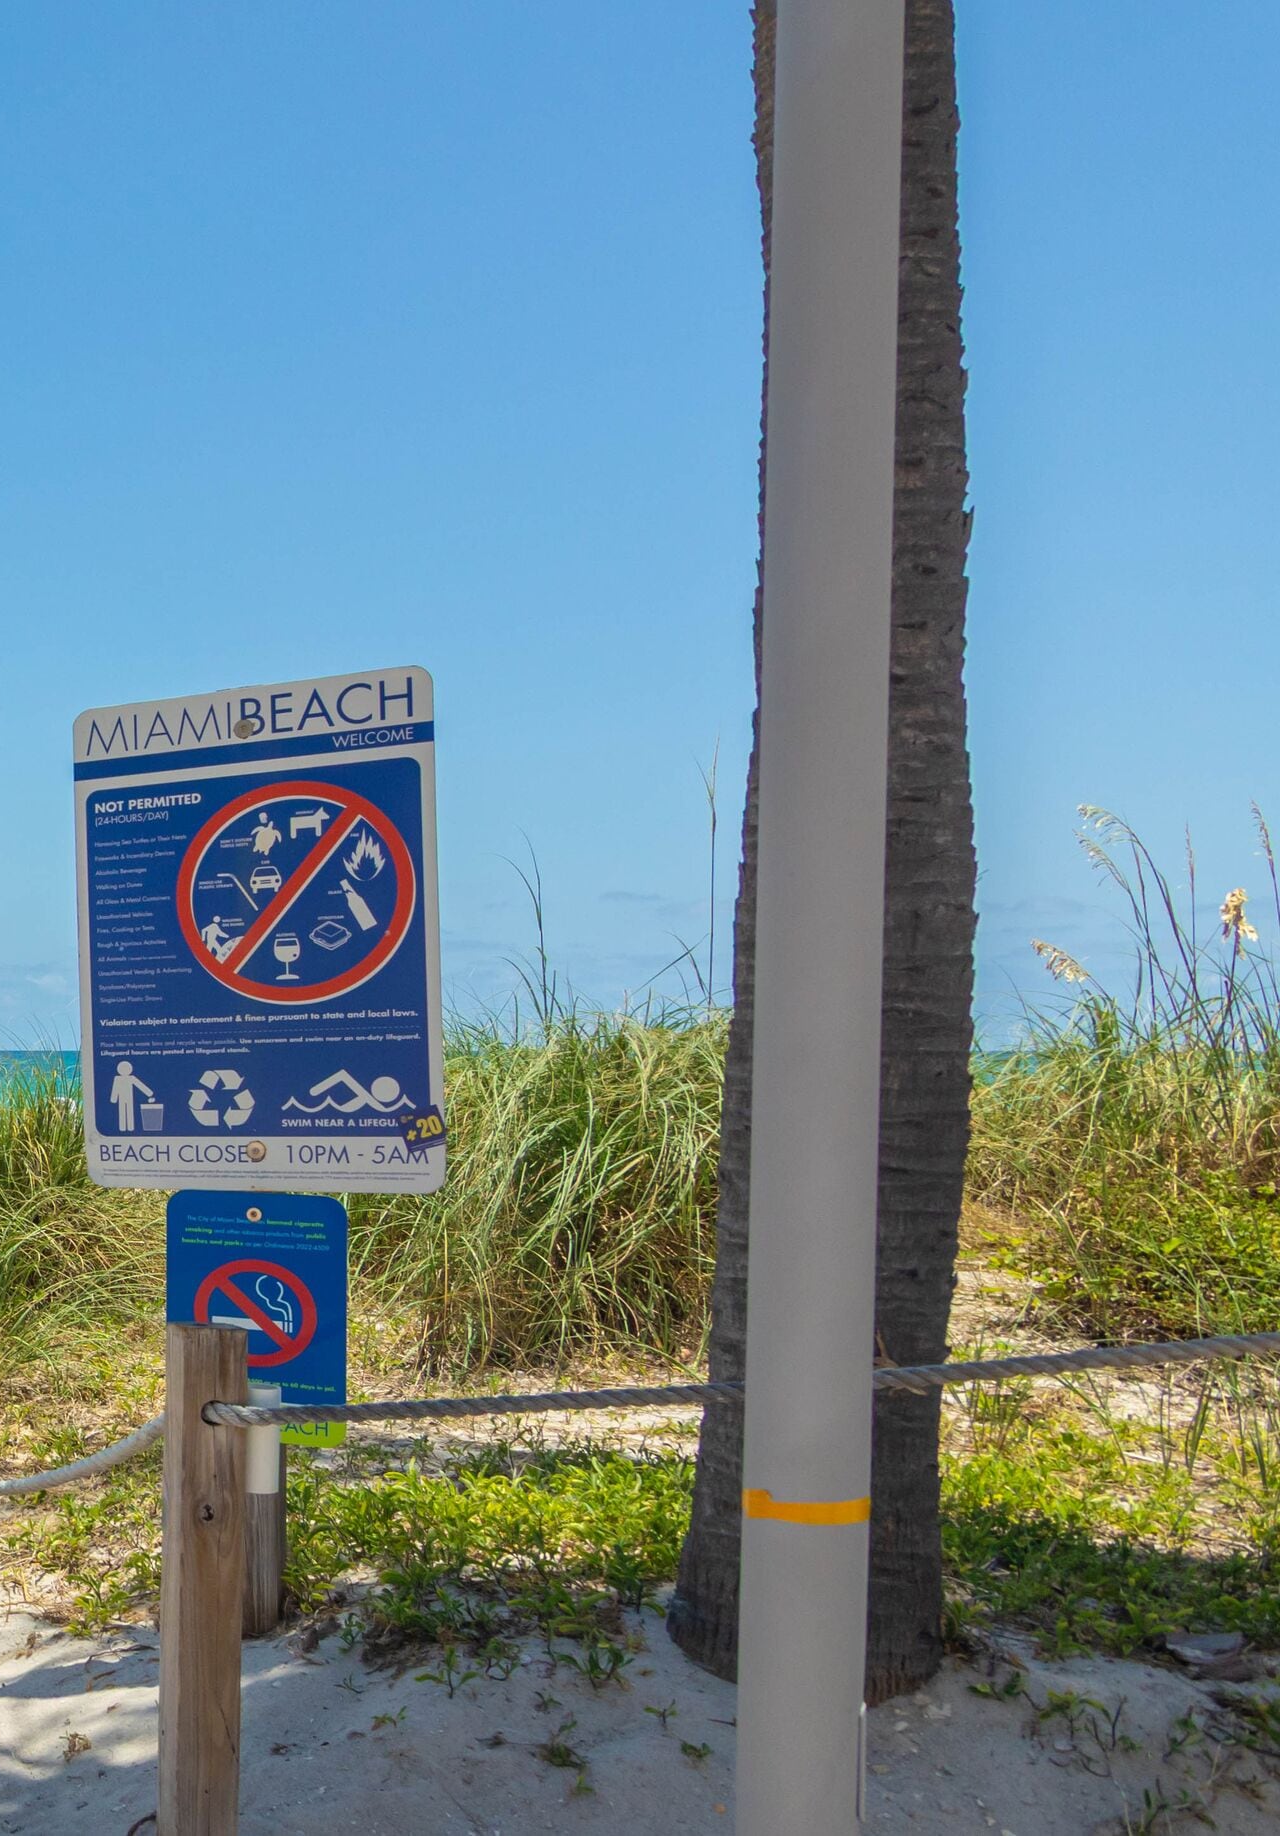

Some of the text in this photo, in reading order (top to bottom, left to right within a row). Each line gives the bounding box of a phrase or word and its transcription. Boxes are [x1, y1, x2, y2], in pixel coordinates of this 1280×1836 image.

[332, 726, 414, 748] WELCOME
[94, 793, 201, 813] NOT PERMITTED
[95, 811, 168, 827] (24-HOURS/DAY)
[100, 1018, 137, 1027] Violators
[138, 1017, 167, 1026] subject
[180, 1015, 233, 1024] enforcement
[235, 1014, 242, 1022] &
[244, 1013, 266, 1021] fines
[268, 1013, 308, 1022] pursuant
[347, 1010, 366, 1018] and
[367, 1009, 390, 1017] local
[392, 1009, 419, 1017] laws.
[355, 1034, 384, 1042] on-duty
[385, 1032, 421, 1041] lifeguard.
[100, 1049, 130, 1057] Lifeguard
[131, 1048, 149, 1056] hours
[162, 1048, 185, 1056] posted
[196, 1047, 226, 1055] lifeguard
[281, 1118, 399, 1128] SWIM NEAR A LIFEGU
[100, 1144, 170, 1162] BEACH
[178, 1144, 266, 1163] CLOSE
[286, 1144, 350, 1164] 10PM
[371, 1145, 429, 1164] 5AM
[293, 1220, 325, 1228] cigarette
[181, 1237, 208, 1245] beaches
[324, 1385, 337, 1393] jail.
[280, 1421, 329, 1437] ACH
